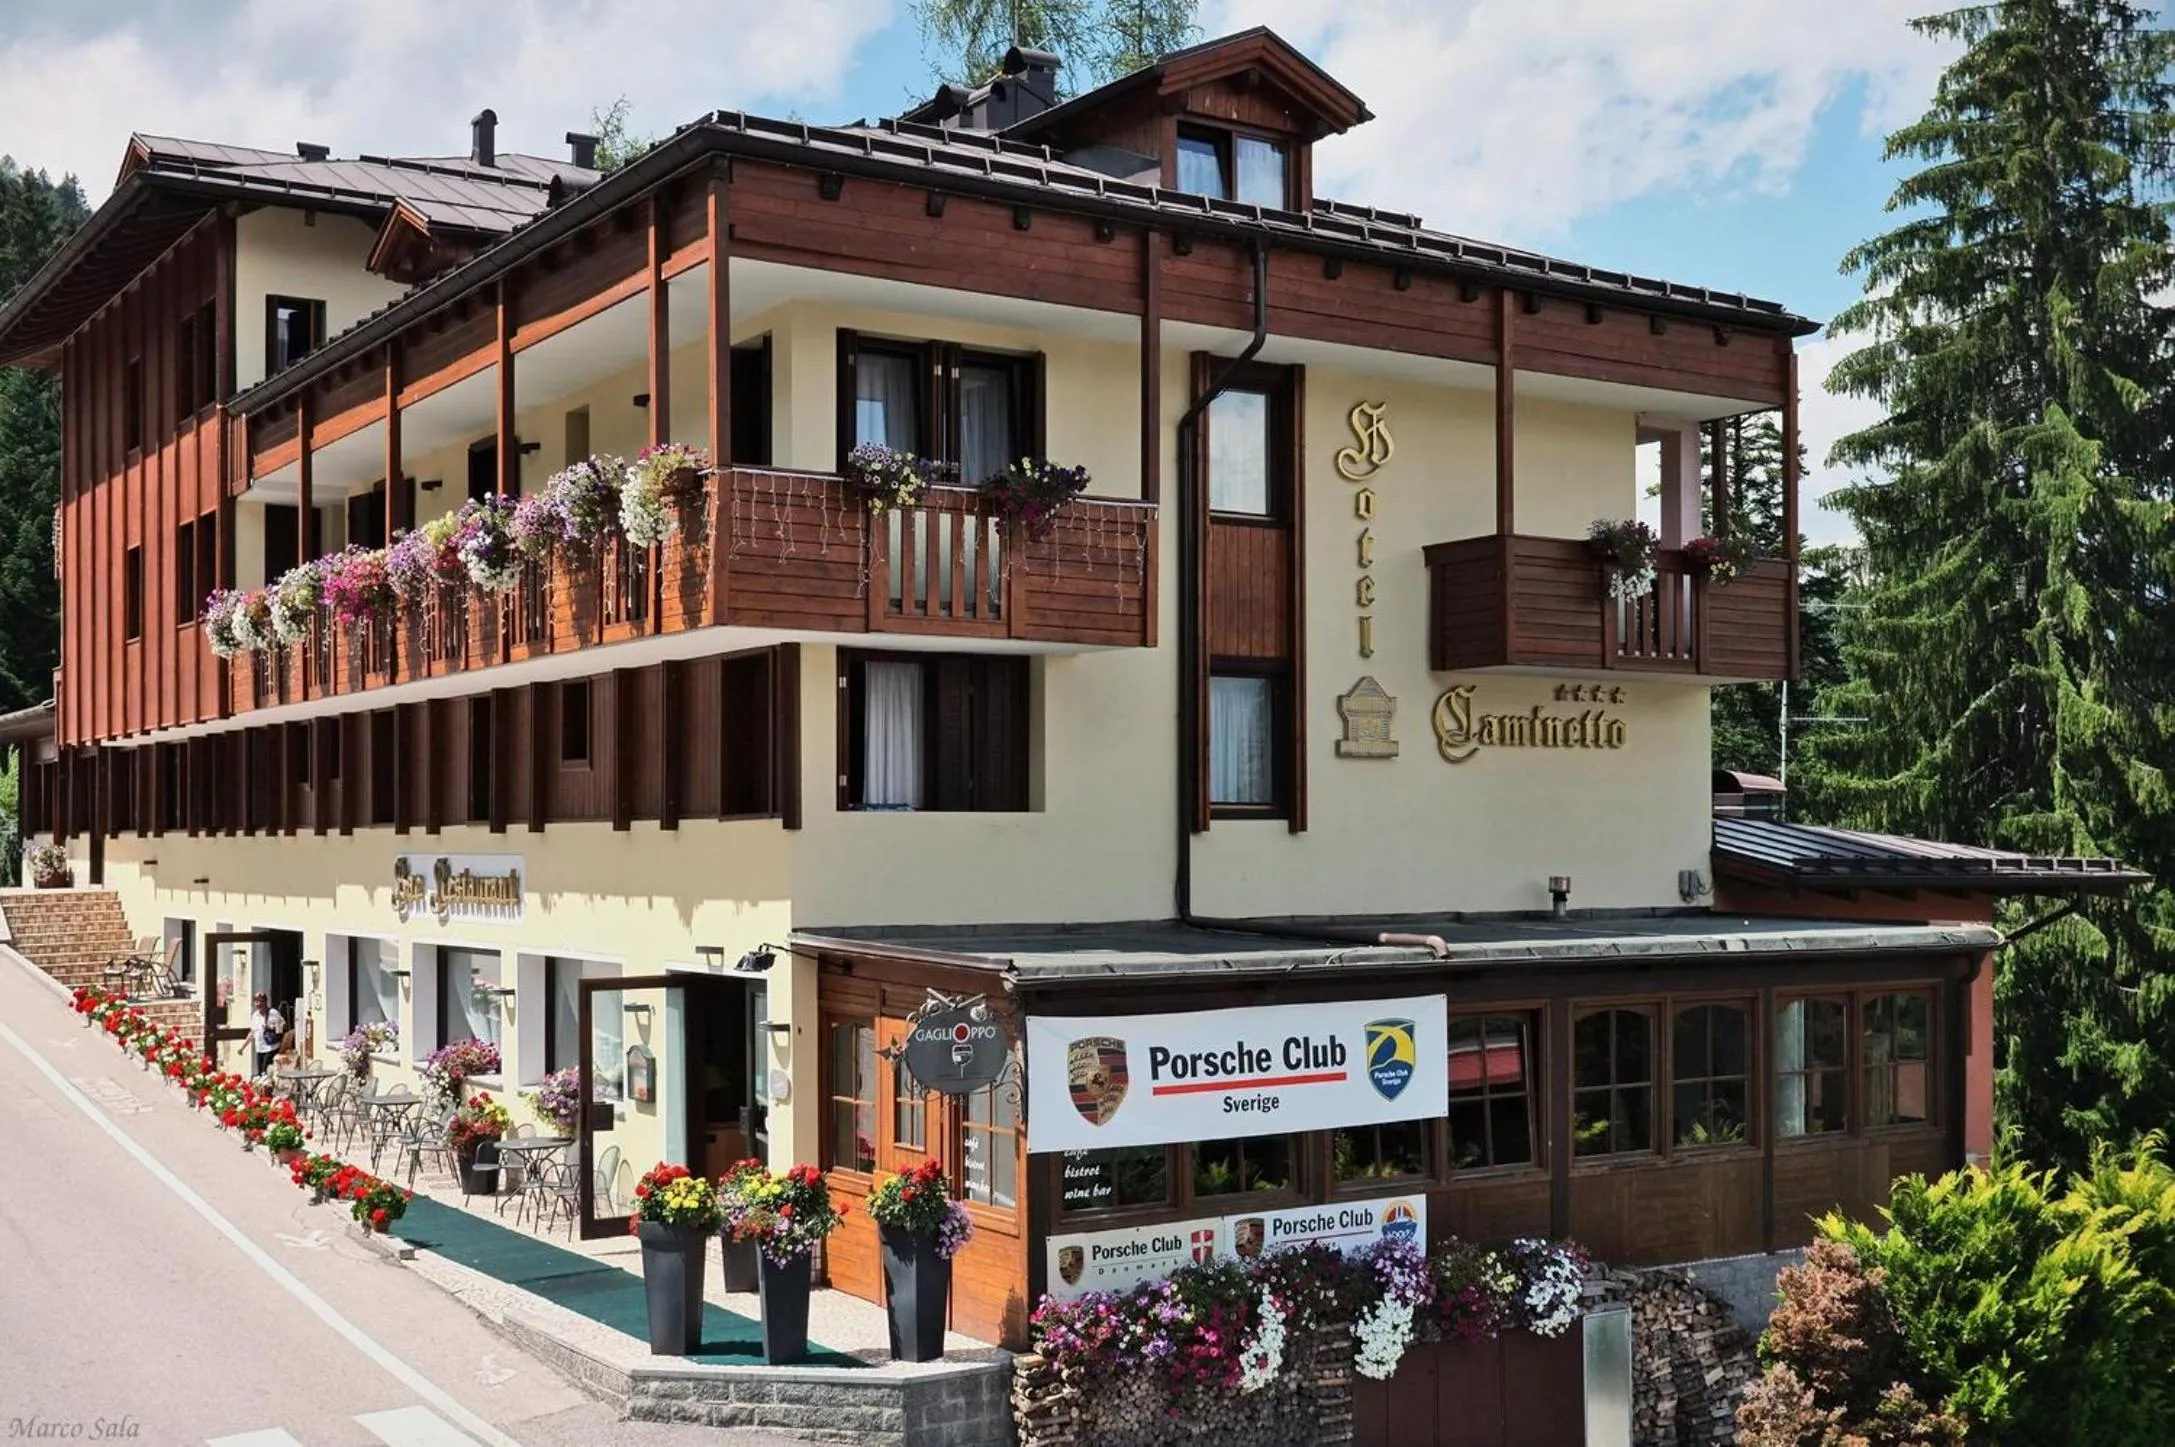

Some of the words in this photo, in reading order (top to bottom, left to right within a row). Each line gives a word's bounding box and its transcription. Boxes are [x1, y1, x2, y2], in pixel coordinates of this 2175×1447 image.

[1336, 401, 1395, 659] Hotel
[1432, 684, 1628, 764] Caminetto
[915, 1022, 996, 1043] GAGLIOPPO
[1149, 1041, 1272, 1080] Porsche
[1283, 1035, 1347, 1071] Club
[1223, 1094, 1280, 1113] Sverige
[1064, 1165, 1100, 1178] bistrot
[1064, 1187, 1090, 1200] wine
[1093, 1183, 1112, 1197] bar
[1272, 1213, 1335, 1236] Porsche
[1339, 1208, 1374, 1229] Club
[1092, 1240, 1147, 1261] Porsche
[1151, 1235, 1182, 1253] Club
